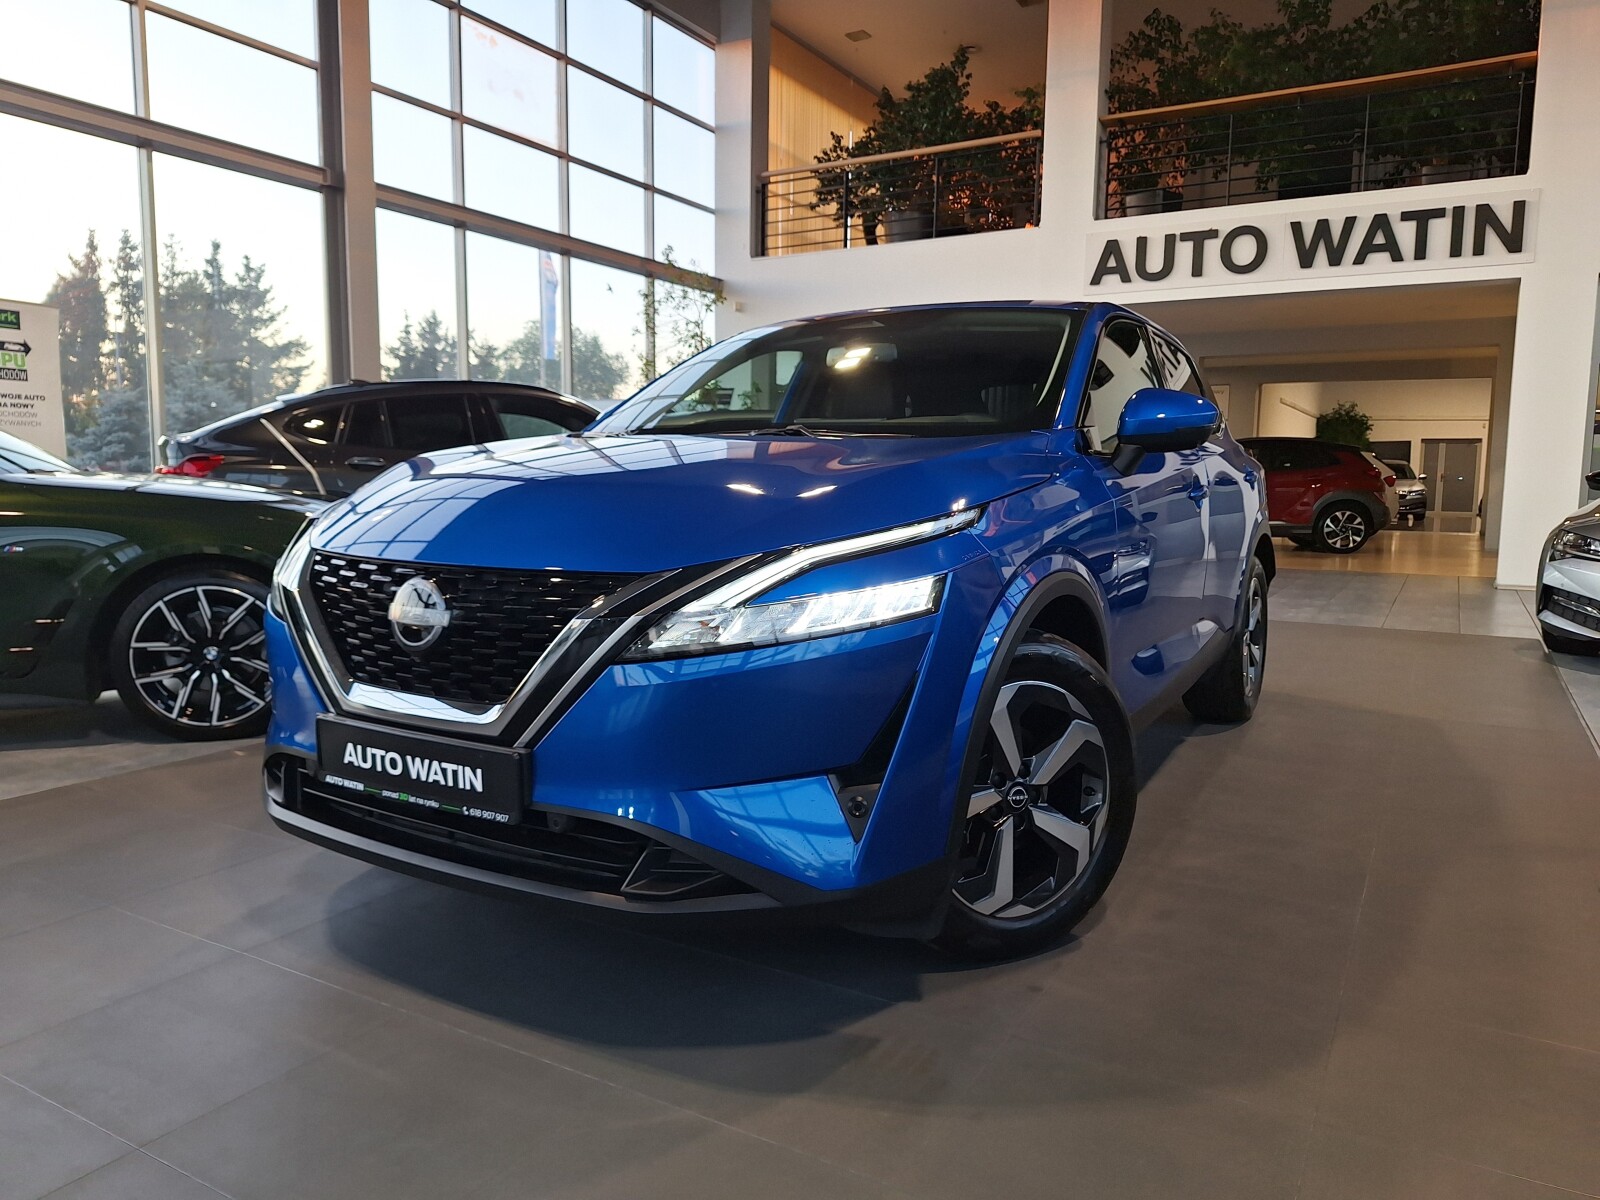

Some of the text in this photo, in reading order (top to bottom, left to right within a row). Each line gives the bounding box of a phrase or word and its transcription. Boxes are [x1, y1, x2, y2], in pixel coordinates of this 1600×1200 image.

[1090, 200, 1527, 286] AUTO WATIN
[0, 311, 17, 322] rk
[343, 742, 483, 792] AUTO WATIN
[325, 774, 365, 791] AUTO WATIN
[482, 810, 496, 820] 907
[495, 813, 510, 823] 907
